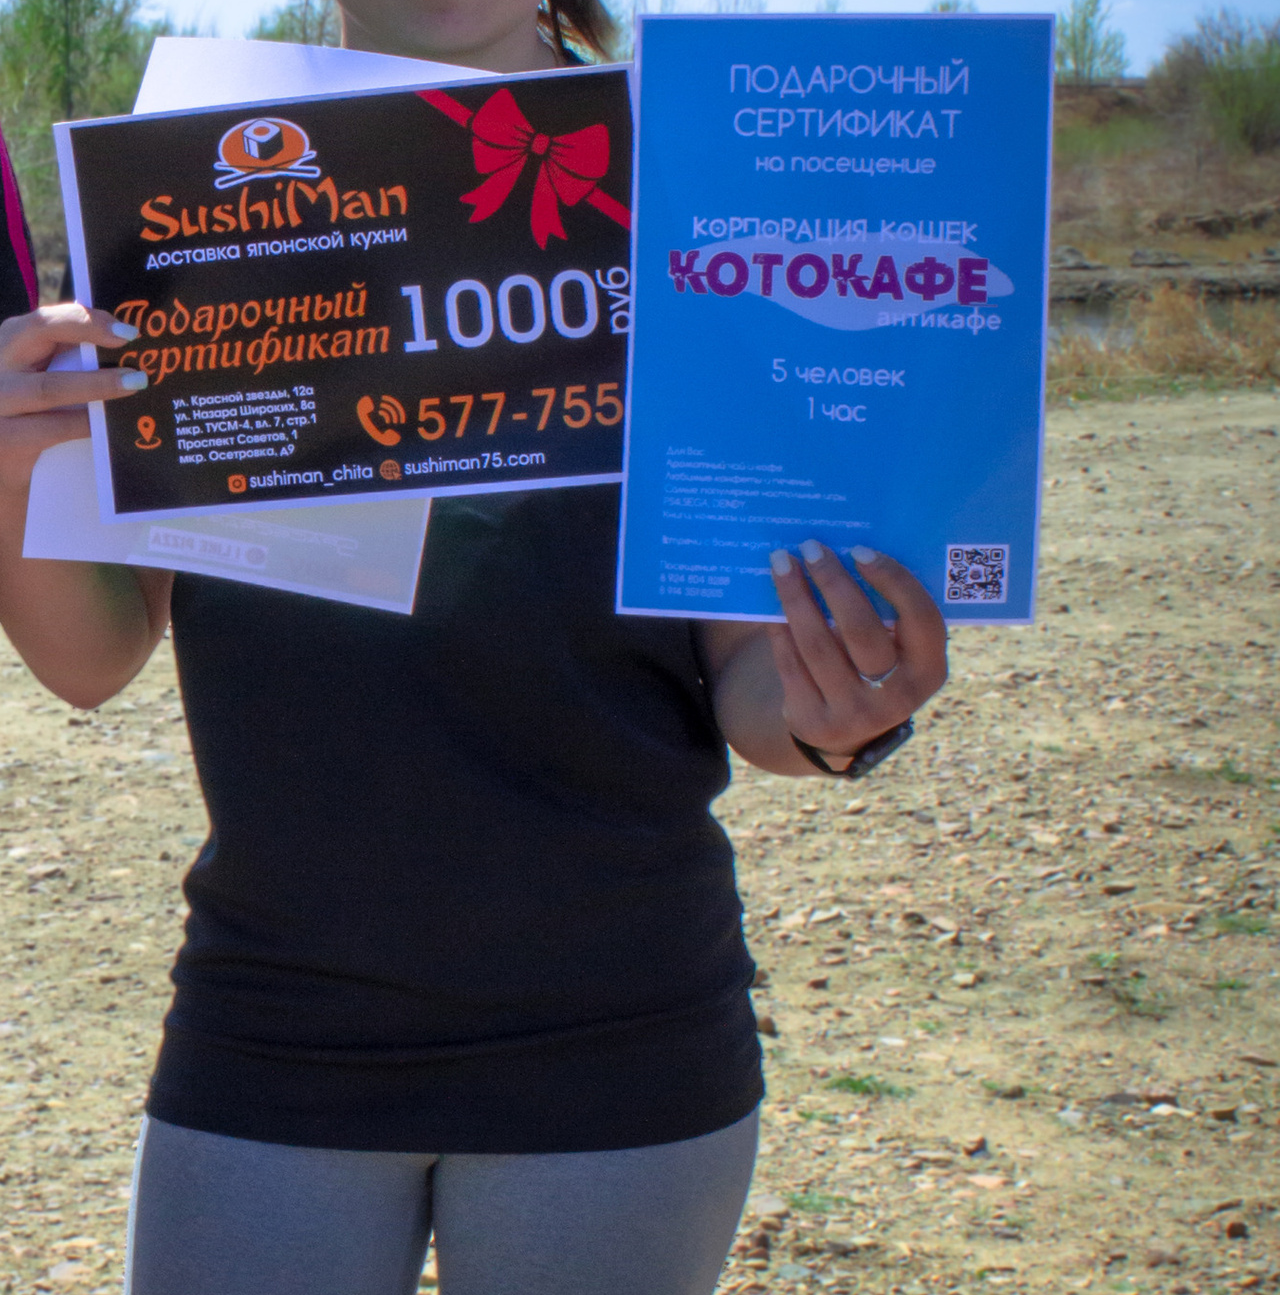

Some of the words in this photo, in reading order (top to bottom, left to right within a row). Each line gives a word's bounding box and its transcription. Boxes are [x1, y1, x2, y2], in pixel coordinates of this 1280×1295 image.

[729, 58, 969, 98] ПОДАРОЧНЫЙ
[733, 108, 962, 139] СЕРТИФИКАТ
[755, 156, 784, 172] на
[790, 156, 936, 177] посещение
[140, 176, 408, 241] SushiMan
[692, 216, 868, 245] КОРПОРАЦИЯ
[880, 219, 979, 244] КОШЕК
[146, 243, 241, 270] доставка
[246, 230, 344, 258] японской
[350, 228, 408, 250] кухни
[667, 250, 989, 305] КОТОКАФЕ
[114, 282, 368, 343] Подарочный
[400, 269, 600, 353] 1000
[877, 308, 1002, 336] антикафе
[119, 326, 391, 386] сертификат
[771, 358, 788, 383] 5
[794, 366, 906, 387] человек
[172, 398, 189, 410] ул.
[190, 391, 244, 408] Красной
[417, 382, 624, 441] 577-755
[807, 396, 814, 420] 1
[821, 403, 867, 422] час
[174, 411, 191, 424] ул.
[192, 407, 238, 421] Назара
[176, 426, 204, 437] мкр.
[204, 419, 253, 433] ТУСМ-4,
[255, 419, 272, 429] вл.
[177, 436, 235, 451] Проспект
[290, 429, 298, 440] 1
[179, 454, 207, 465] мкр.
[280, 444, 295, 457] д9
[249, 464, 374, 488] sushiman_chita
[404, 450, 546, 475] sushiman75.com
